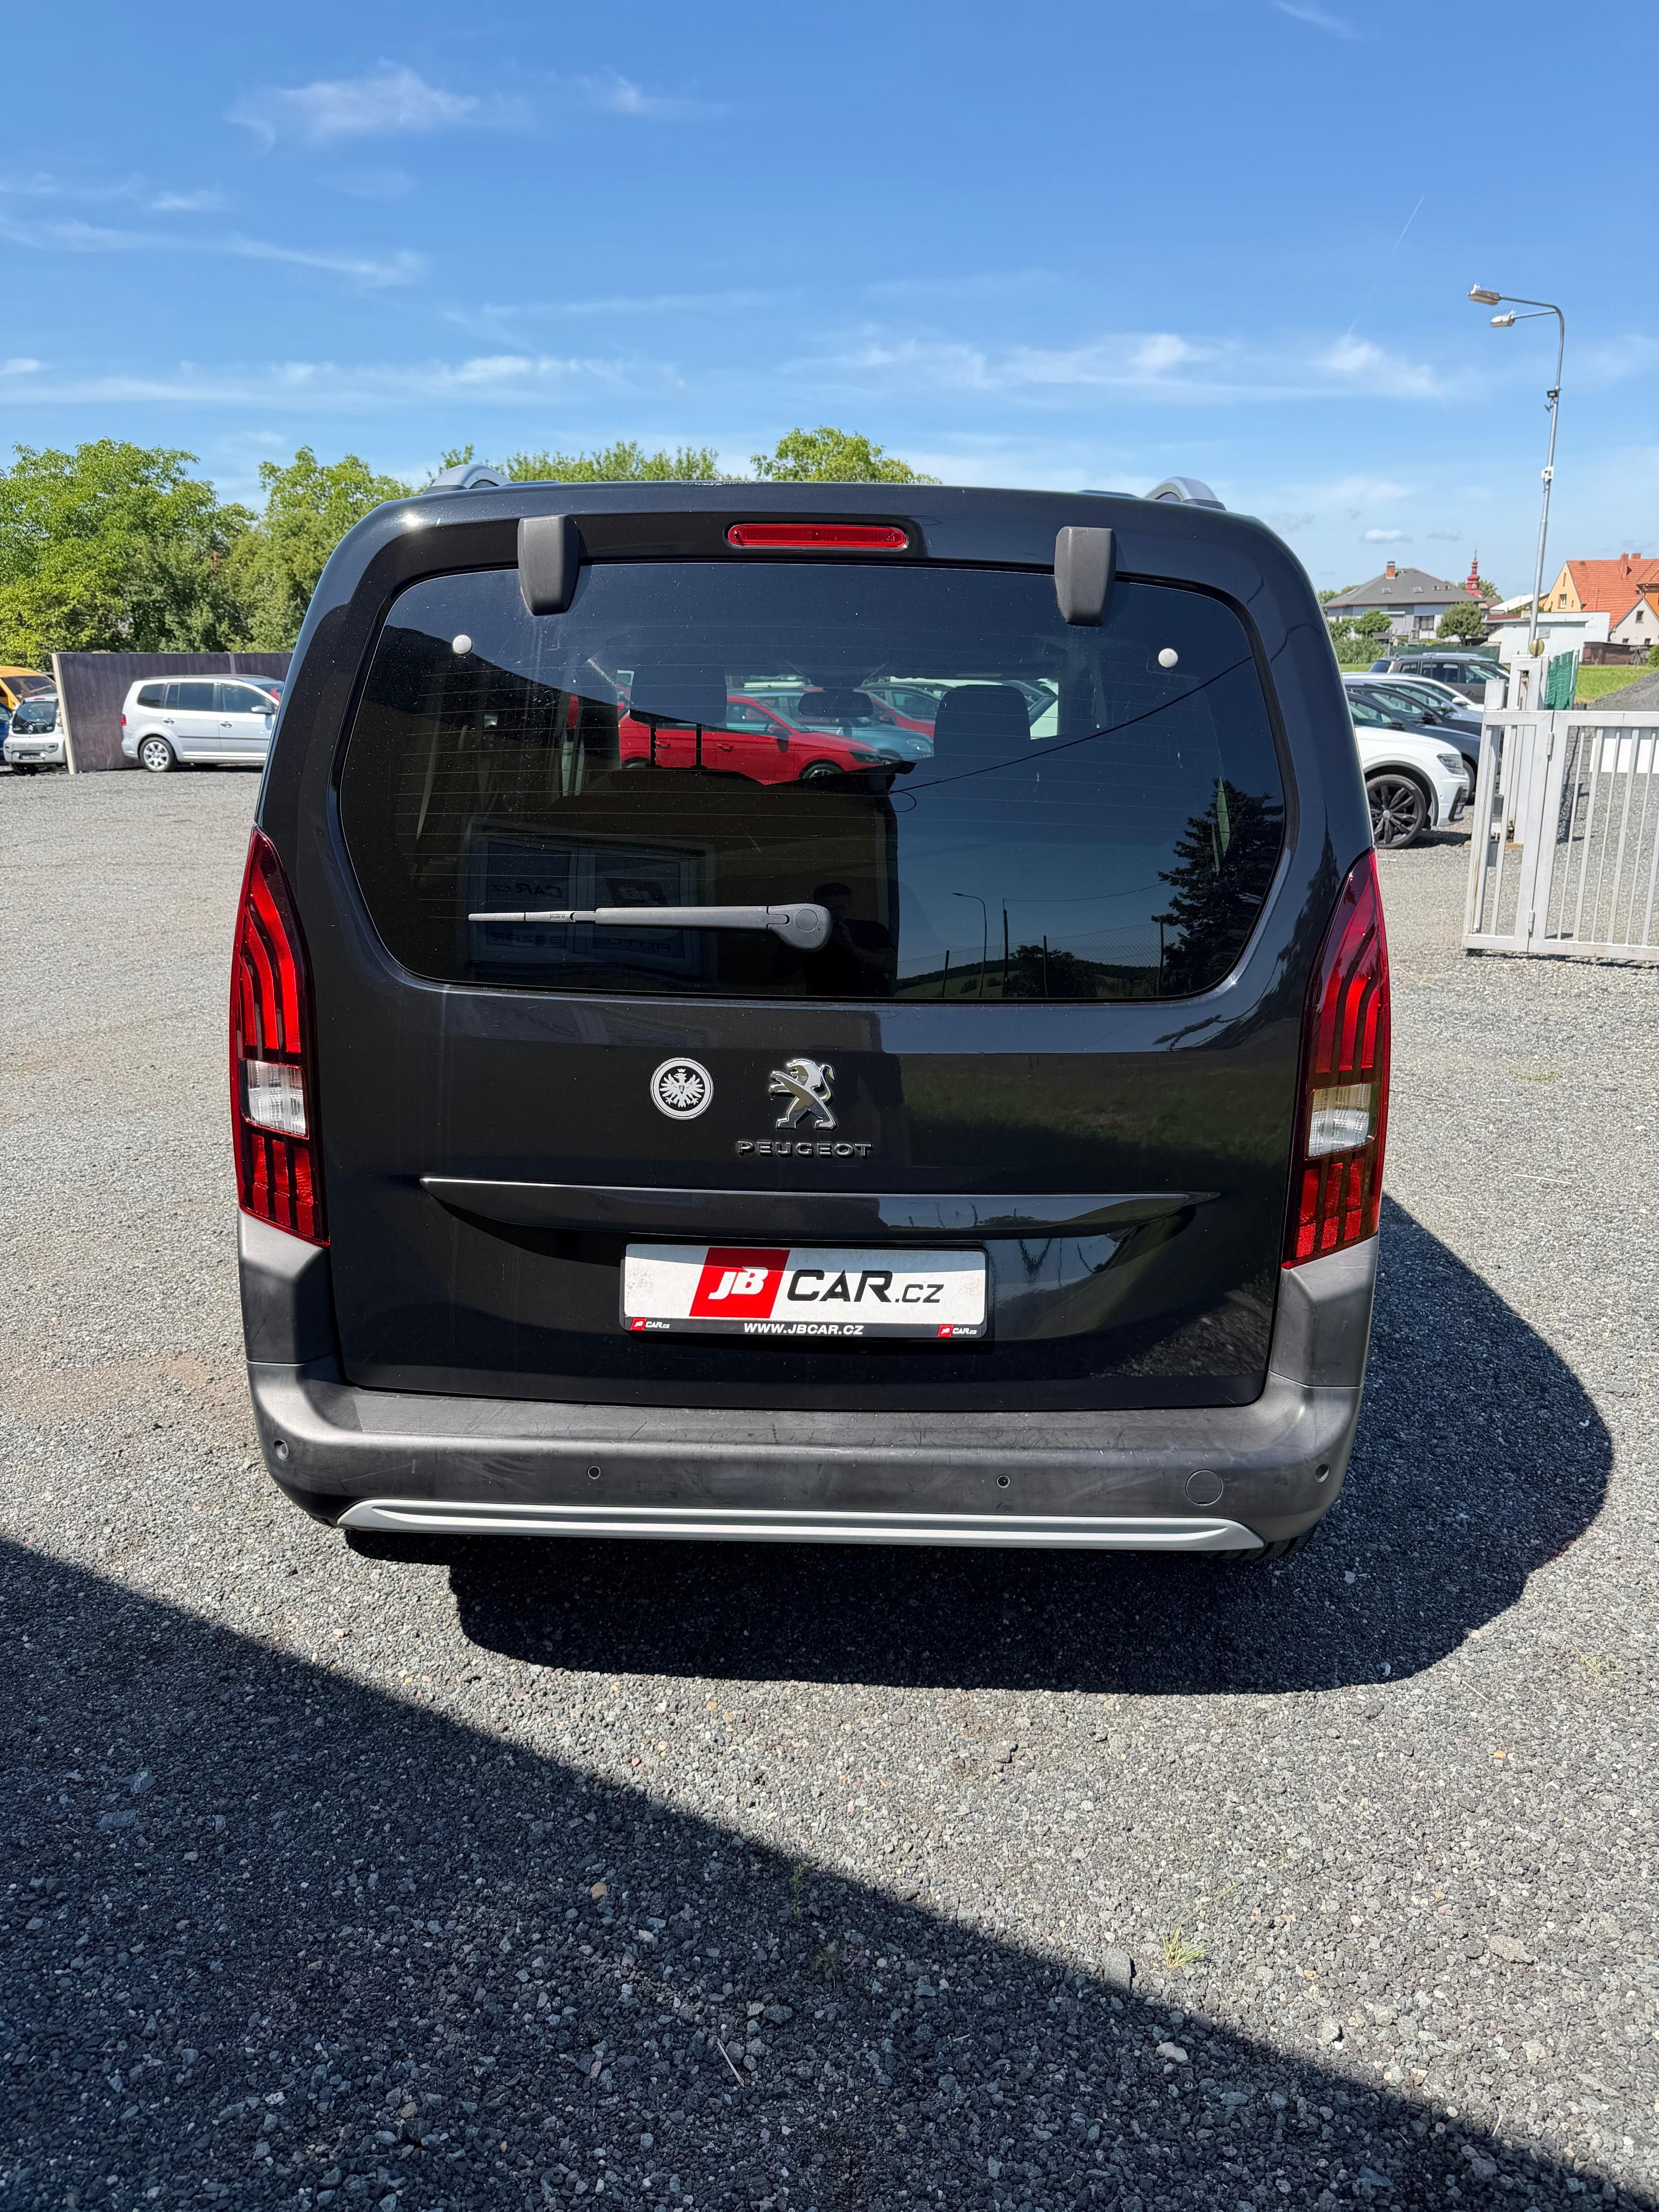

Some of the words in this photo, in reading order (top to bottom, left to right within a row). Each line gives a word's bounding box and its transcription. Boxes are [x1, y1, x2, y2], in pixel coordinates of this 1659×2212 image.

[737, 1140, 873, 1157] PEUGEOT
[708, 1266, 769, 1299] JB
[744, 1323, 865, 1335] WWW.JBCAR.CZ
